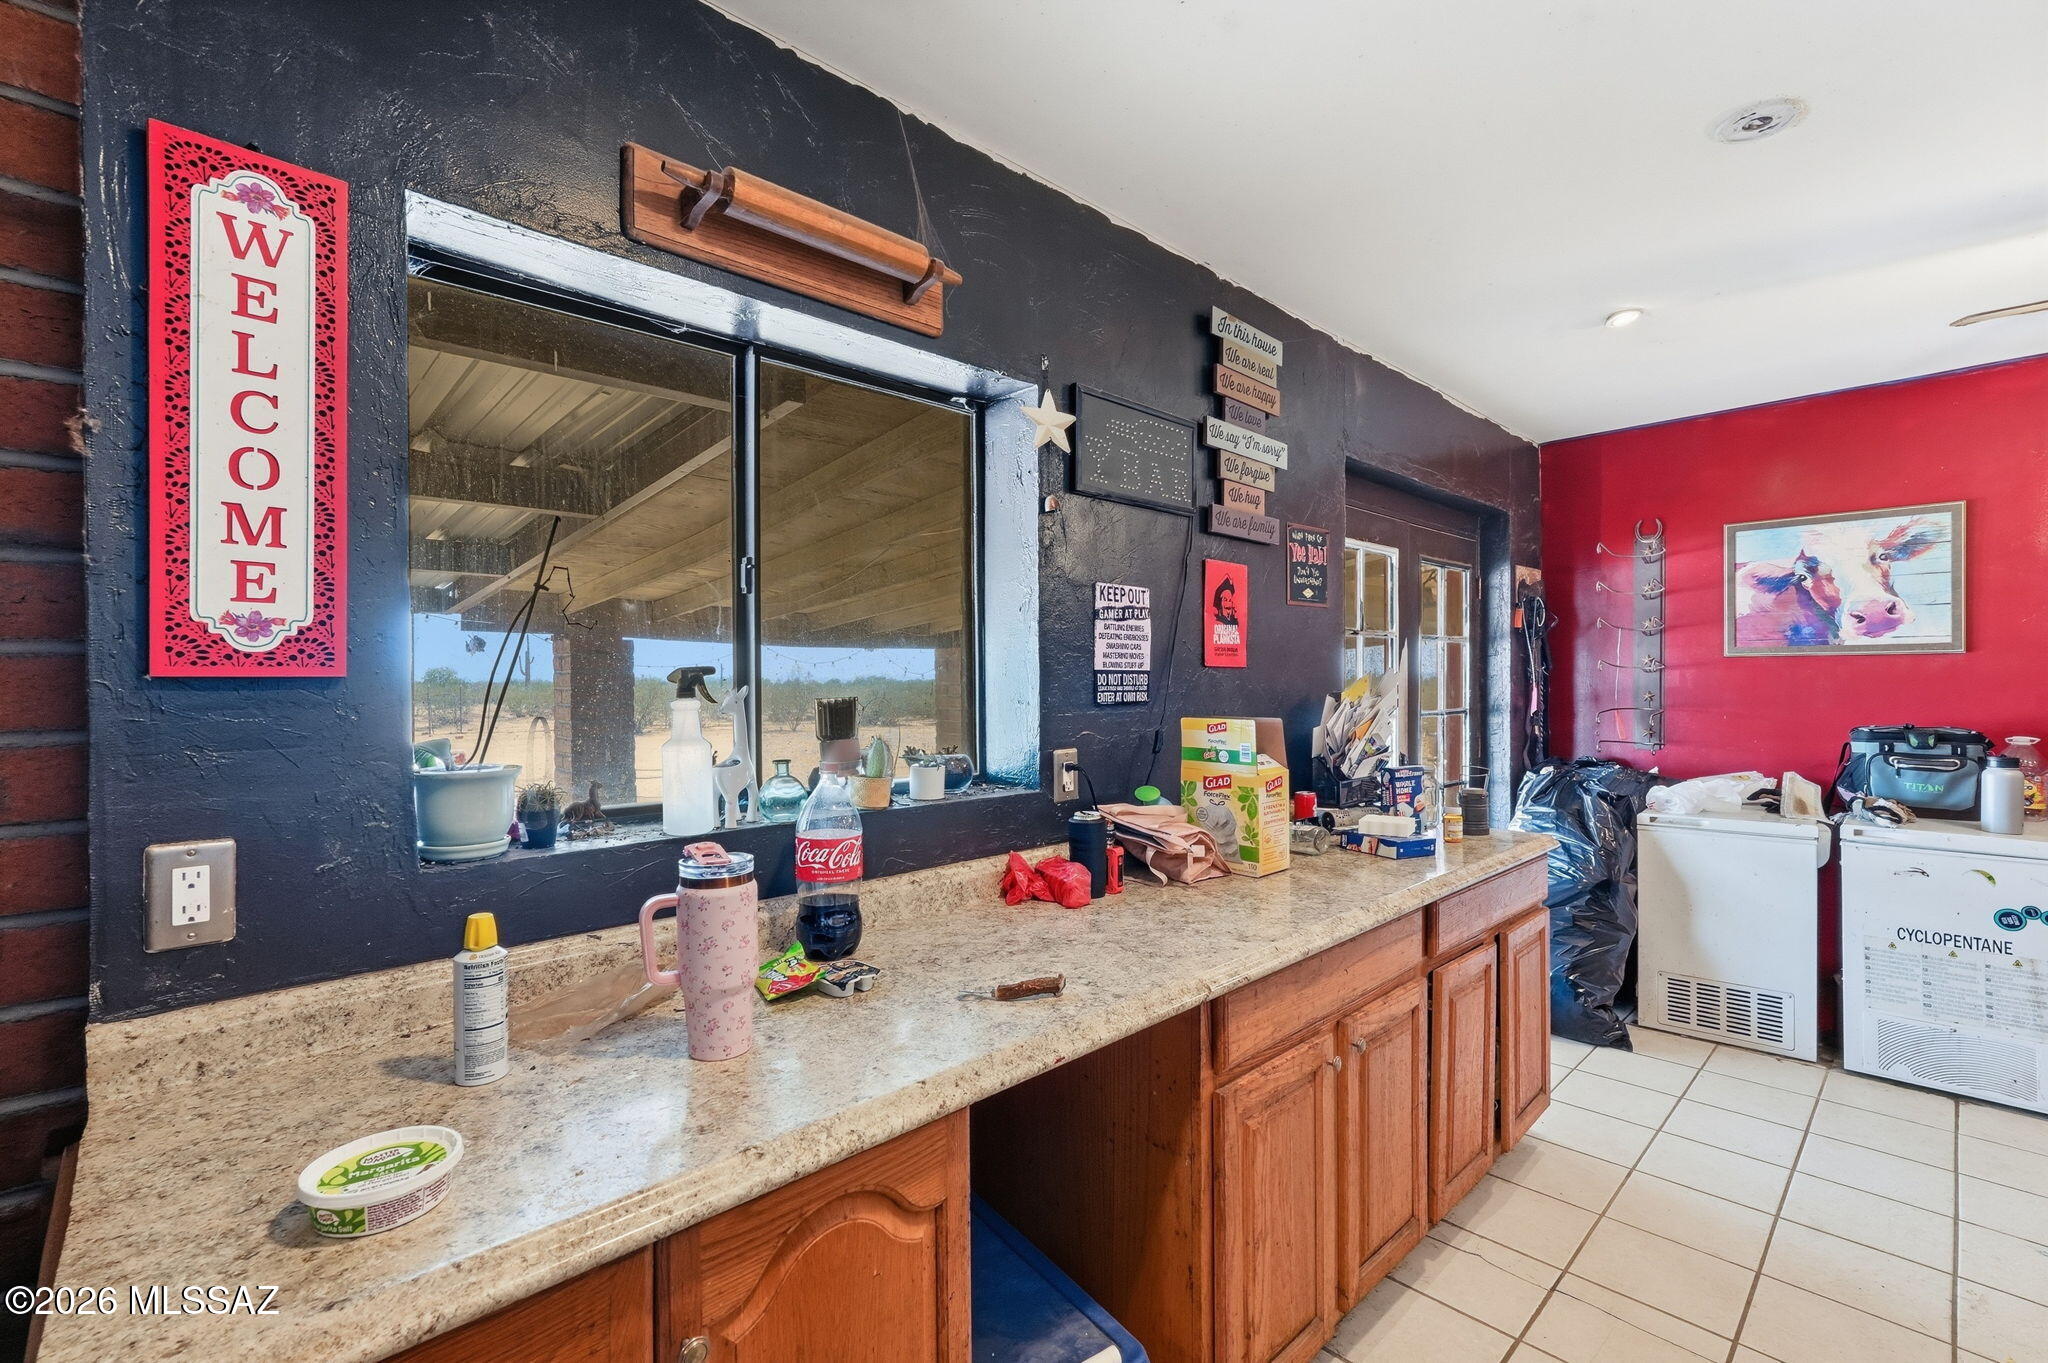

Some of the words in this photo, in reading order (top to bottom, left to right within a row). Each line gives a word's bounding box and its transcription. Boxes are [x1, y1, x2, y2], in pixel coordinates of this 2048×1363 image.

[1218, 316, 1232, 334] In
[1234, 324, 1250, 343] this
[1252, 333, 1277, 356] house
[1225, 347, 1240, 365] We
[1242, 358, 1257, 372] are
[1257, 364, 1274, 380] real
[1220, 372, 1236, 390] We
[1236, 383, 1252, 396] are
[1252, 387, 1276, 408] happy
[216, 211, 294, 604] WELCOME
[1228, 405, 1244, 421] We
[1245, 410, 1262, 428] love
[1209, 424, 1224, 440] We
[1226, 434, 1240, 449] say
[1120, 448, 1192, 502] BAR
[1224, 457, 1240, 474] We
[1240, 462, 1270, 484] forgive
[1228, 487, 1244, 502] We
[1244, 490, 1261, 510] hug
[1215, 510, 1231, 528] We
[1232, 518, 1247, 530] are
[1248, 516, 1275, 539] family
[1290, 542, 1306, 562] Yee
[1100, 585, 1126, 602] KEEP
[1128, 589, 1146, 604] OUT
[1100, 609, 1123, 620] GAMER
[1124, 609, 1133, 618] AT
[1134, 609, 1149, 618] PLAY
[1104, 624, 1126, 632] BATTLING
[1126, 624, 1144, 632] ENEMIES
[1097, 674, 1107, 686] DO
[1108, 674, 1122, 686] NOT
[1122, 674, 1148, 686] DISTURB
[1097, 692, 1114, 702] ENTER
[1116, 692, 1123, 702] AT
[1124, 692, 1136, 702] OWN
[1136, 692, 1149, 702] RISK
[1208, 724, 1226, 732] GLAD
[1205, 777, 1230, 788] GLAD
[1267, 778, 1282, 792] GLAD
[1904, 782, 1944, 792] TITAN
[1204, 791, 1230, 800] ForceFlex
[798, 839, 863, 870] Coca-Cola
[1897, 927, 2014, 956] CYCLOPENTANE
[348, 1156, 420, 1179] Margarita
